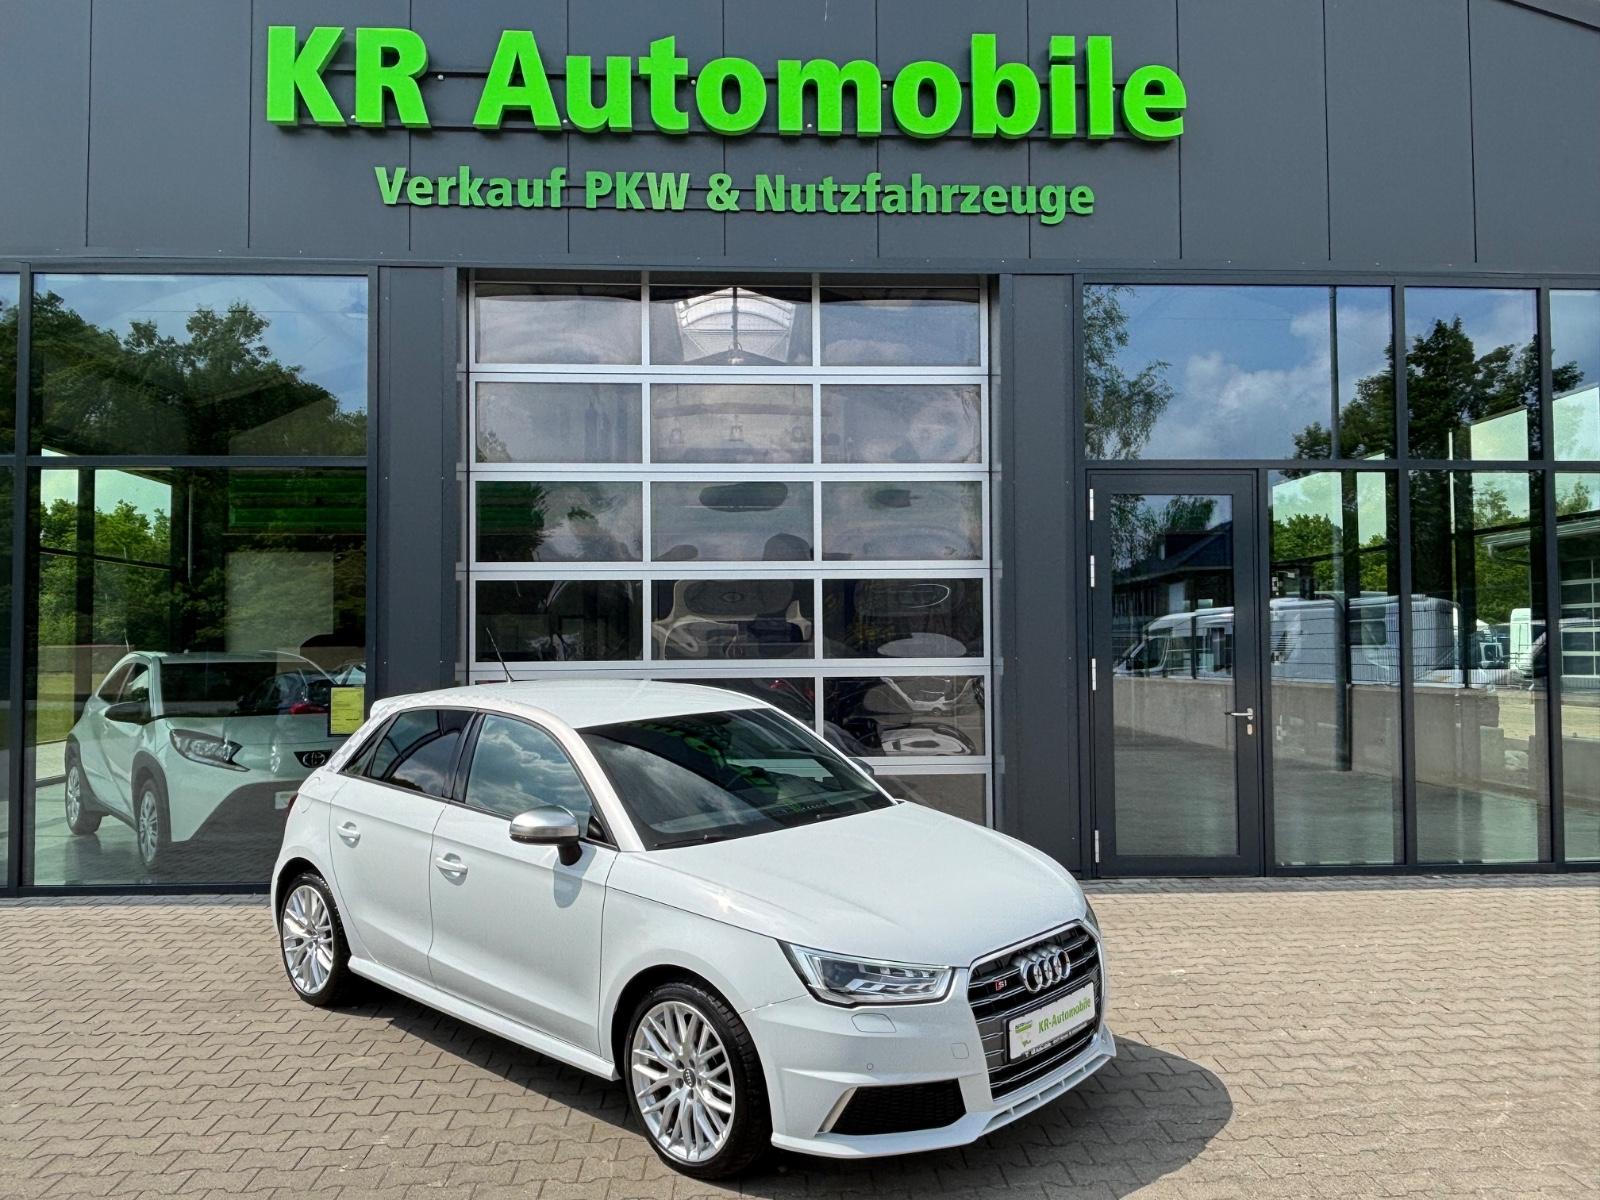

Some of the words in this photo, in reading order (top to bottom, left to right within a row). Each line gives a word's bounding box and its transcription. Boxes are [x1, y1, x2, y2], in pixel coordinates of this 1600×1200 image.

[265, 25, 429, 127] KR
[471, 30, 1187, 141] Automobile
[375, 165, 567, 209] Verkauf
[585, 170, 690, 211] PKW
[707, 172, 740, 213] &
[755, 172, 1095, 225] Nutzfahrzeuge
[1039, 997, 1091, 1033] KR-Automobile
